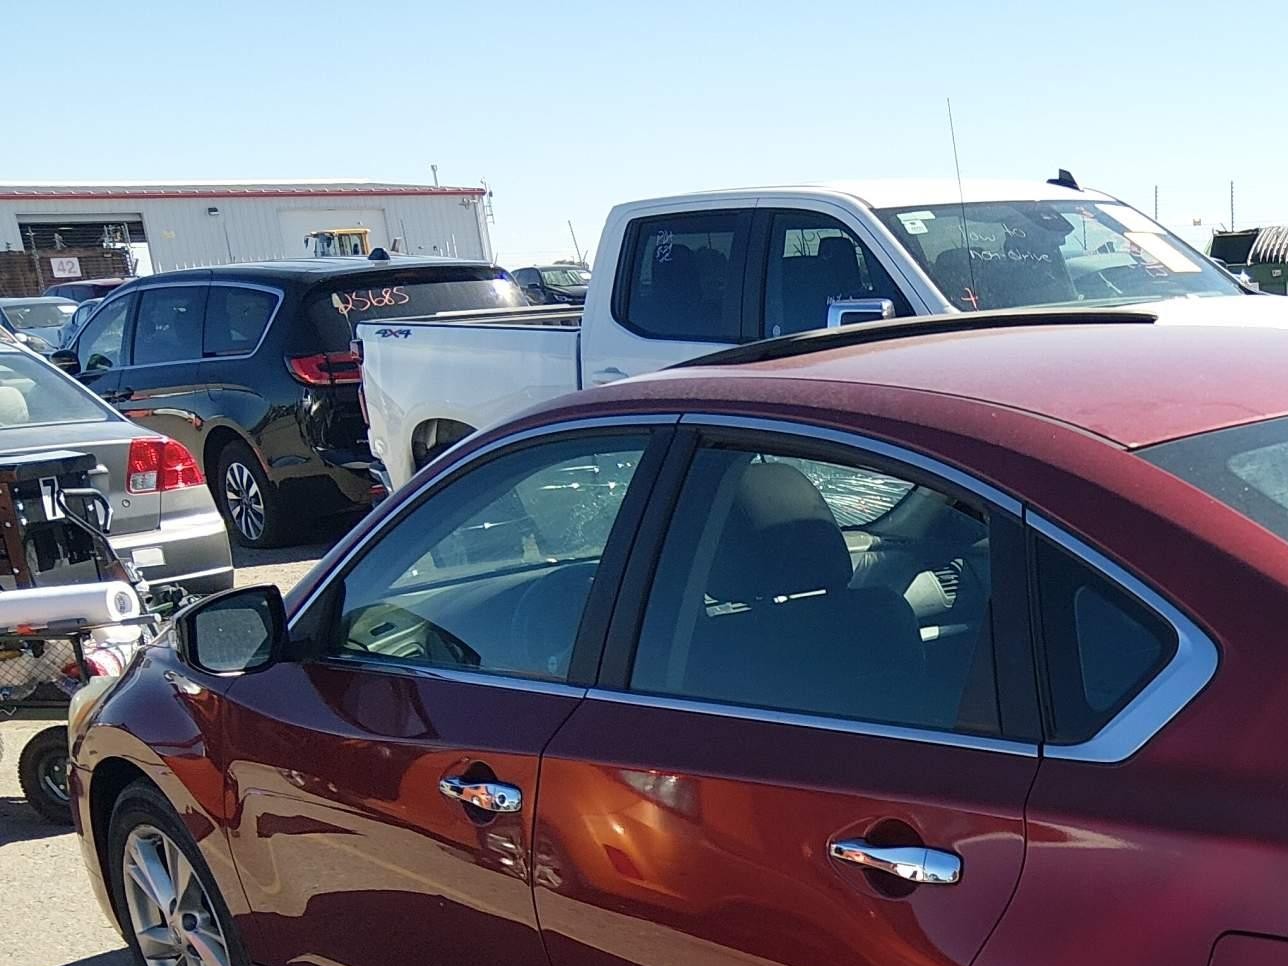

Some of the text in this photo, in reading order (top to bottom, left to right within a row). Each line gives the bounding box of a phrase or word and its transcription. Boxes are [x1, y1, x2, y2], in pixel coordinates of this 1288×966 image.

[57, 259, 78, 274] 42
[338, 285, 410, 314] 25685
[42, 479, 57, 517] 7
